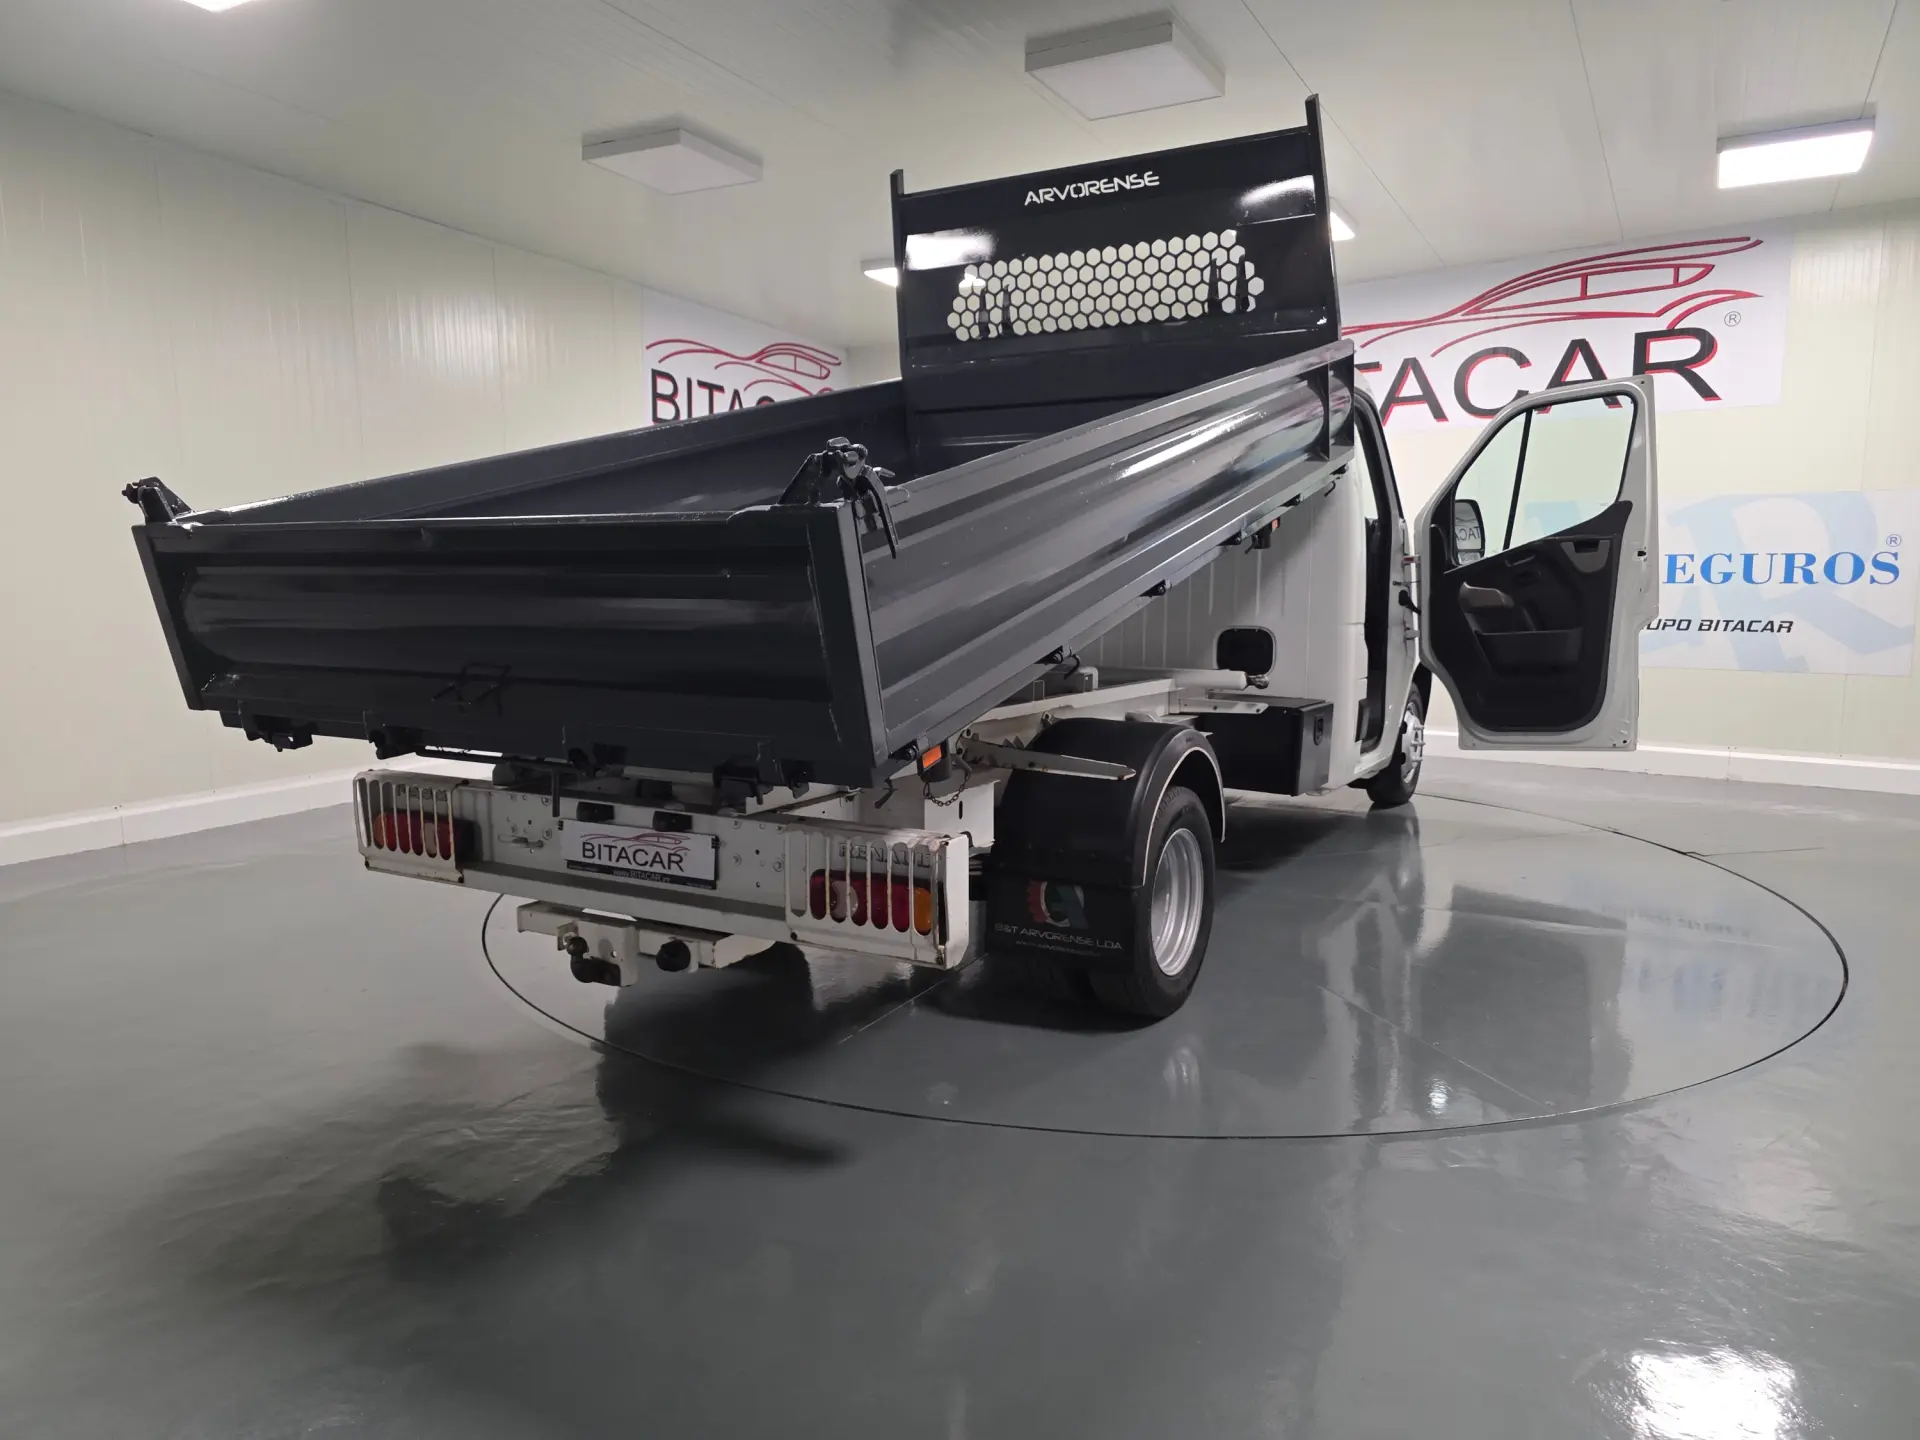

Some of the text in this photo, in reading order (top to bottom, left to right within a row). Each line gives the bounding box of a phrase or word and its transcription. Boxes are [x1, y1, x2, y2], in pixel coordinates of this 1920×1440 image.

[1024, 171, 1160, 206] ARVORENSE
[1353, 327, 1722, 427] ACAR
[1662, 552, 1900, 585] EGUROS
[1643, 619, 1794, 634] UPO BITACAR
[581, 841, 684, 873] BITACAR
